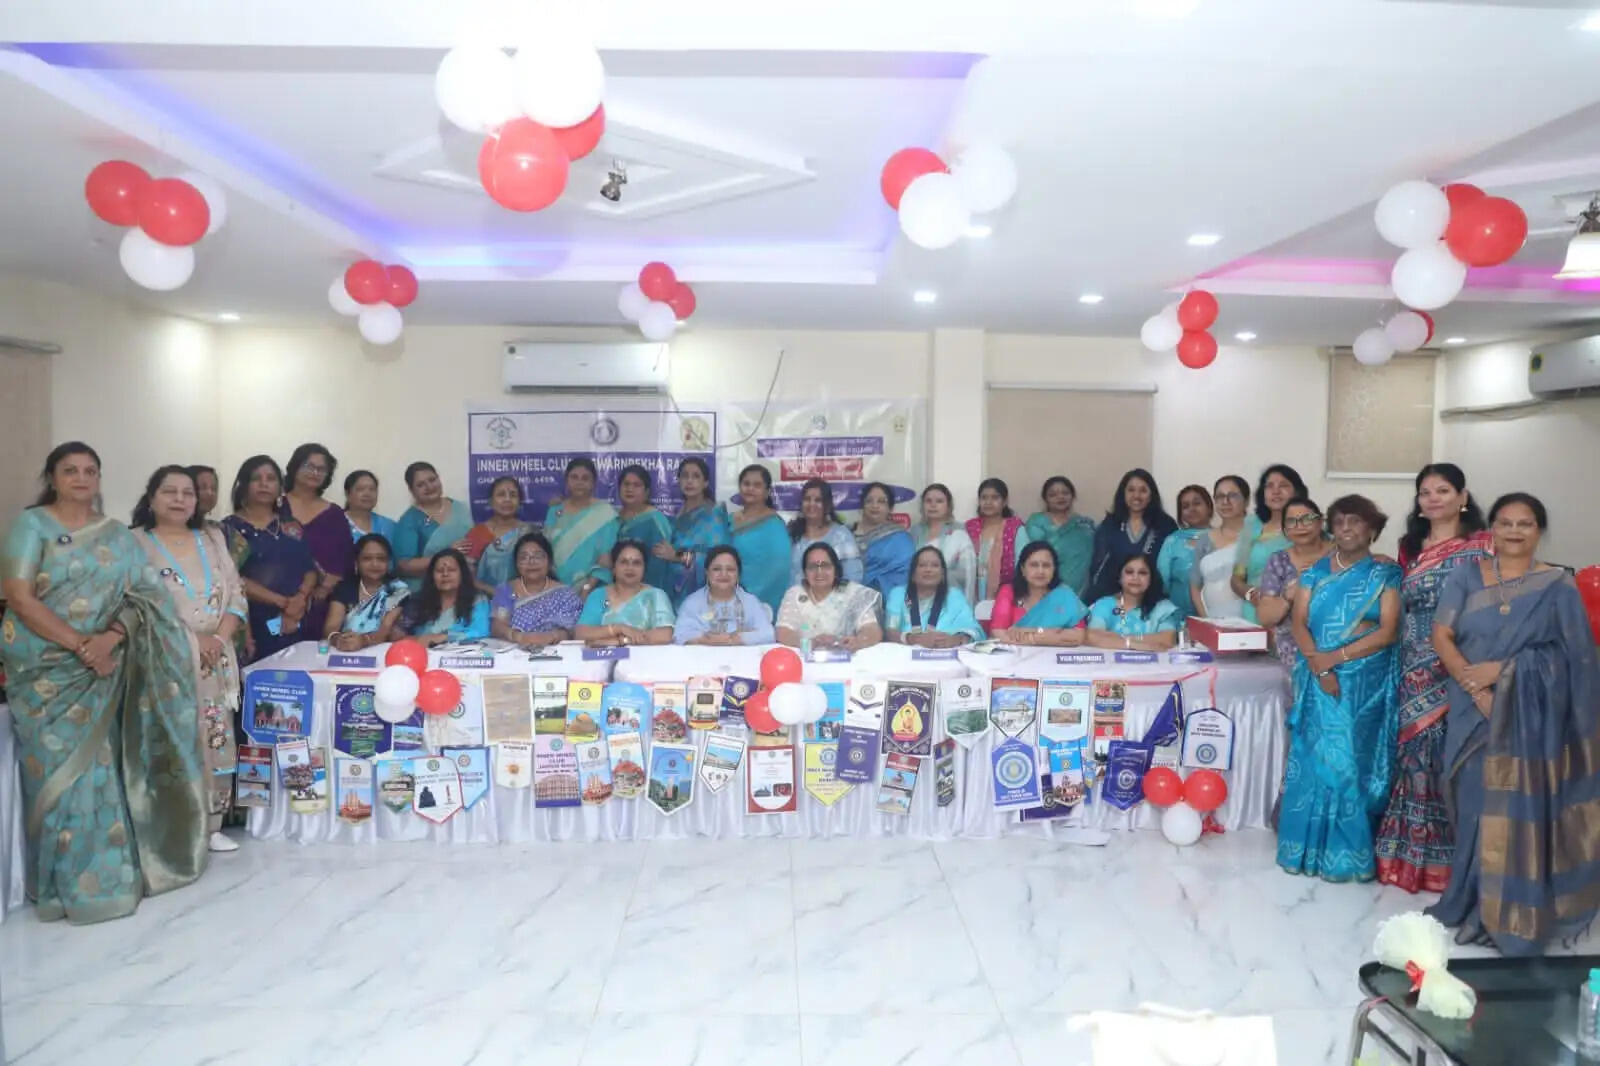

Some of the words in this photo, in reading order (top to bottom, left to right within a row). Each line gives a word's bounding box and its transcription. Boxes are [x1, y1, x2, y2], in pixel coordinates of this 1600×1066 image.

[476, 458, 509, 472] INNER
[511, 457, 546, 472] WHEEL
[547, 457, 572, 471] CLU
